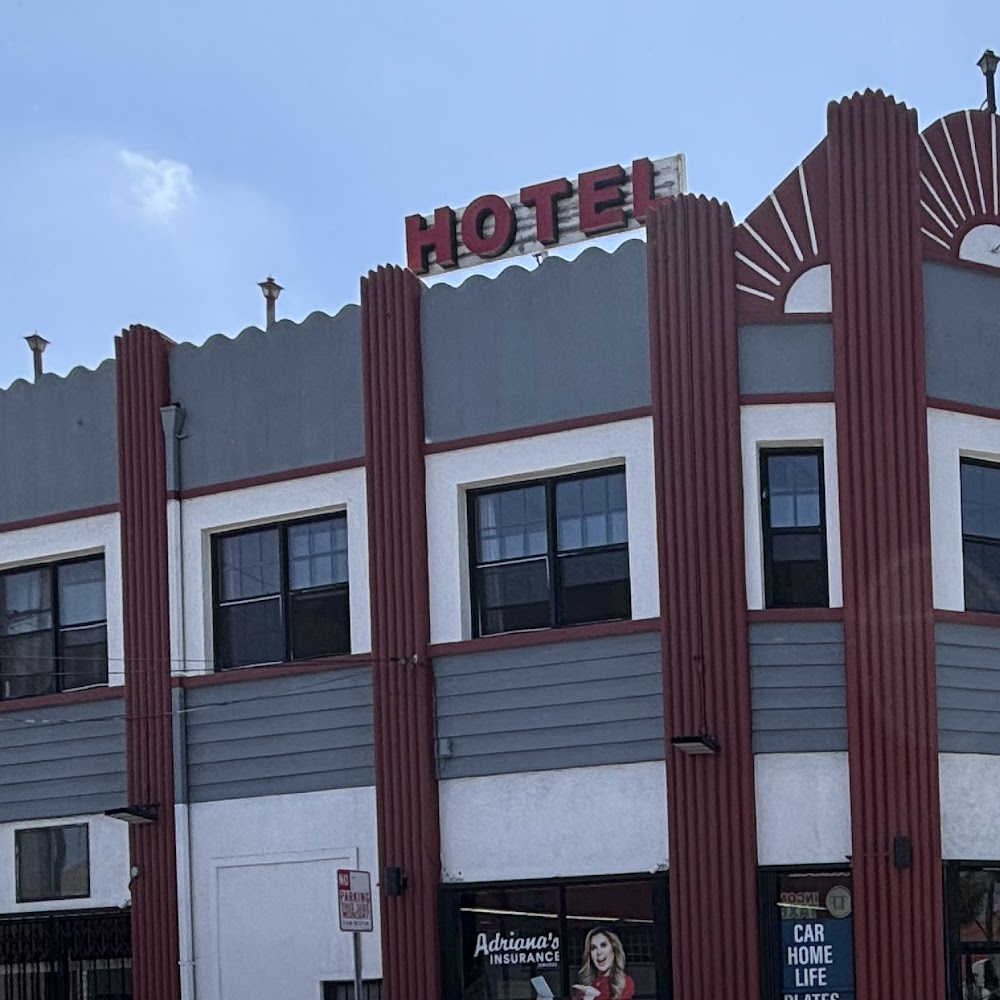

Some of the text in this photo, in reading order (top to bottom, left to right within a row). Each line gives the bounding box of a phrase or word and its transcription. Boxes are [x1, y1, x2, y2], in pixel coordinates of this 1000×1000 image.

[405, 157, 678, 275] HOTEL
[339, 874, 348, 886] NO
[340, 891, 370, 903] PARKING
[794, 923, 825, 943] CAR
[473, 931, 560, 958] Adriana's
[489, 950, 560, 965] INSURANCE
[787, 945, 833, 966] HOME
[795, 967, 828, 987] LIFE
